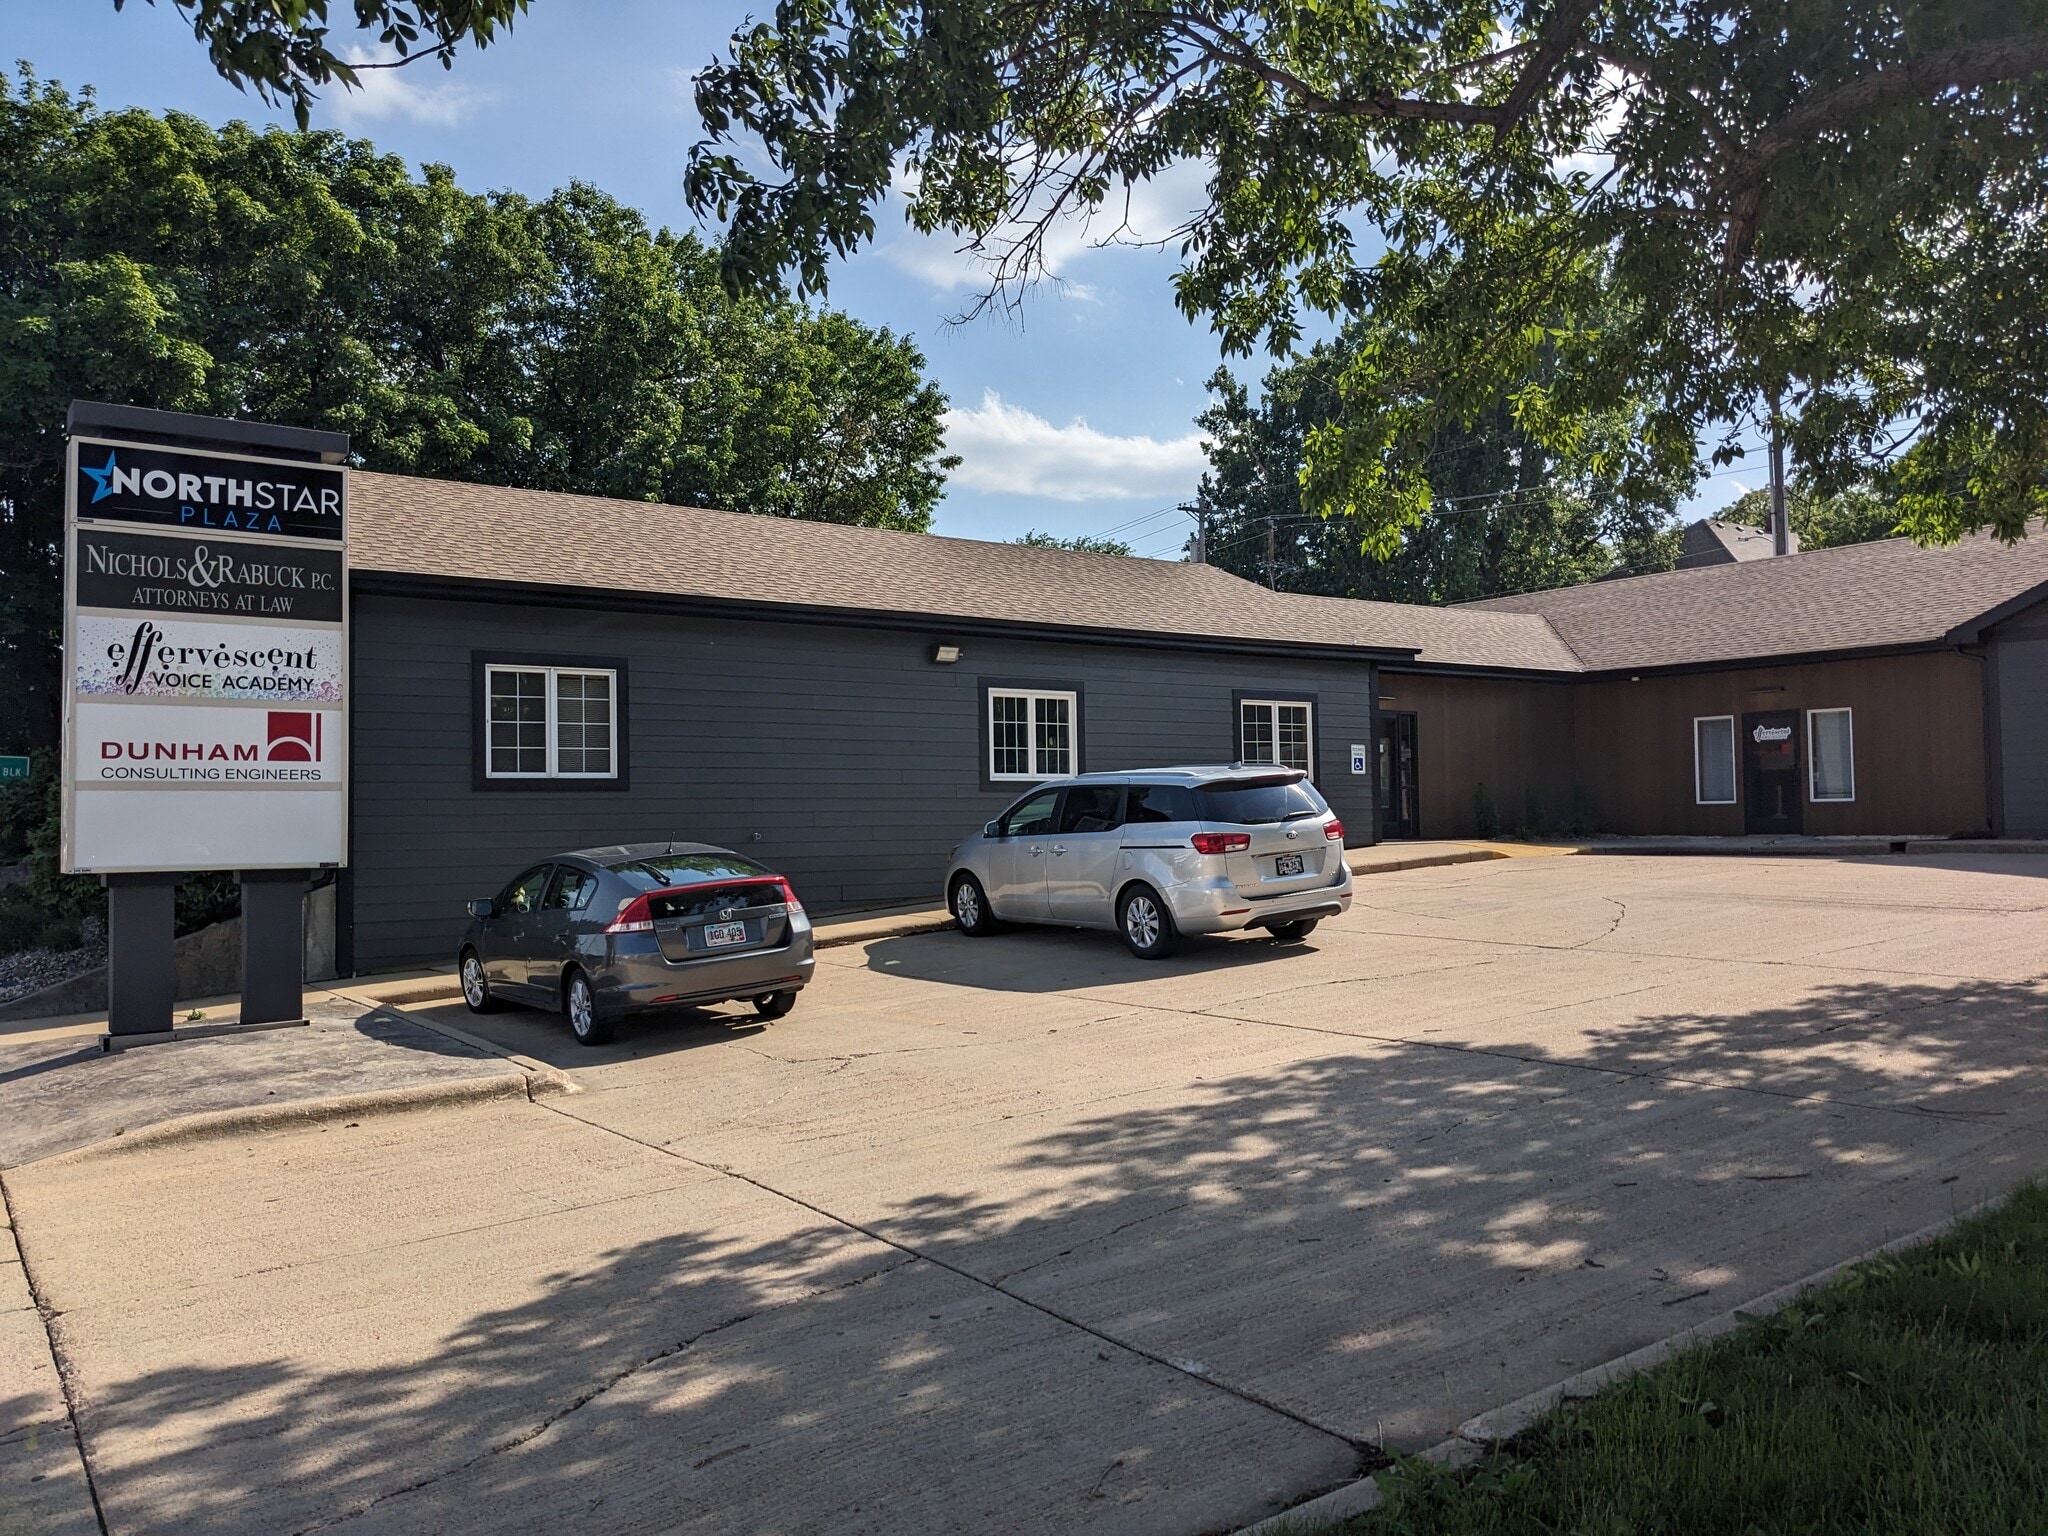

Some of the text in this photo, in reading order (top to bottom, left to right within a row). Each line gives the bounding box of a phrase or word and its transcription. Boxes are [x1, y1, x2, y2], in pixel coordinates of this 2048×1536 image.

[112, 465, 341, 517] NORTHSTAR
[181, 506, 282, 532] PLAZA
[311, 573, 335, 592] P.C.
[132, 587, 293, 613] ATTORNEYS AT LAW
[107, 621, 318, 695] effervescent
[153, 673, 314, 692] VOICE ACADEMY
[101, 741, 258, 761] DUNHAM
[3, 767, 21, 777] BLK
[101, 766, 322, 781] CONSULTING ENGINEERS
